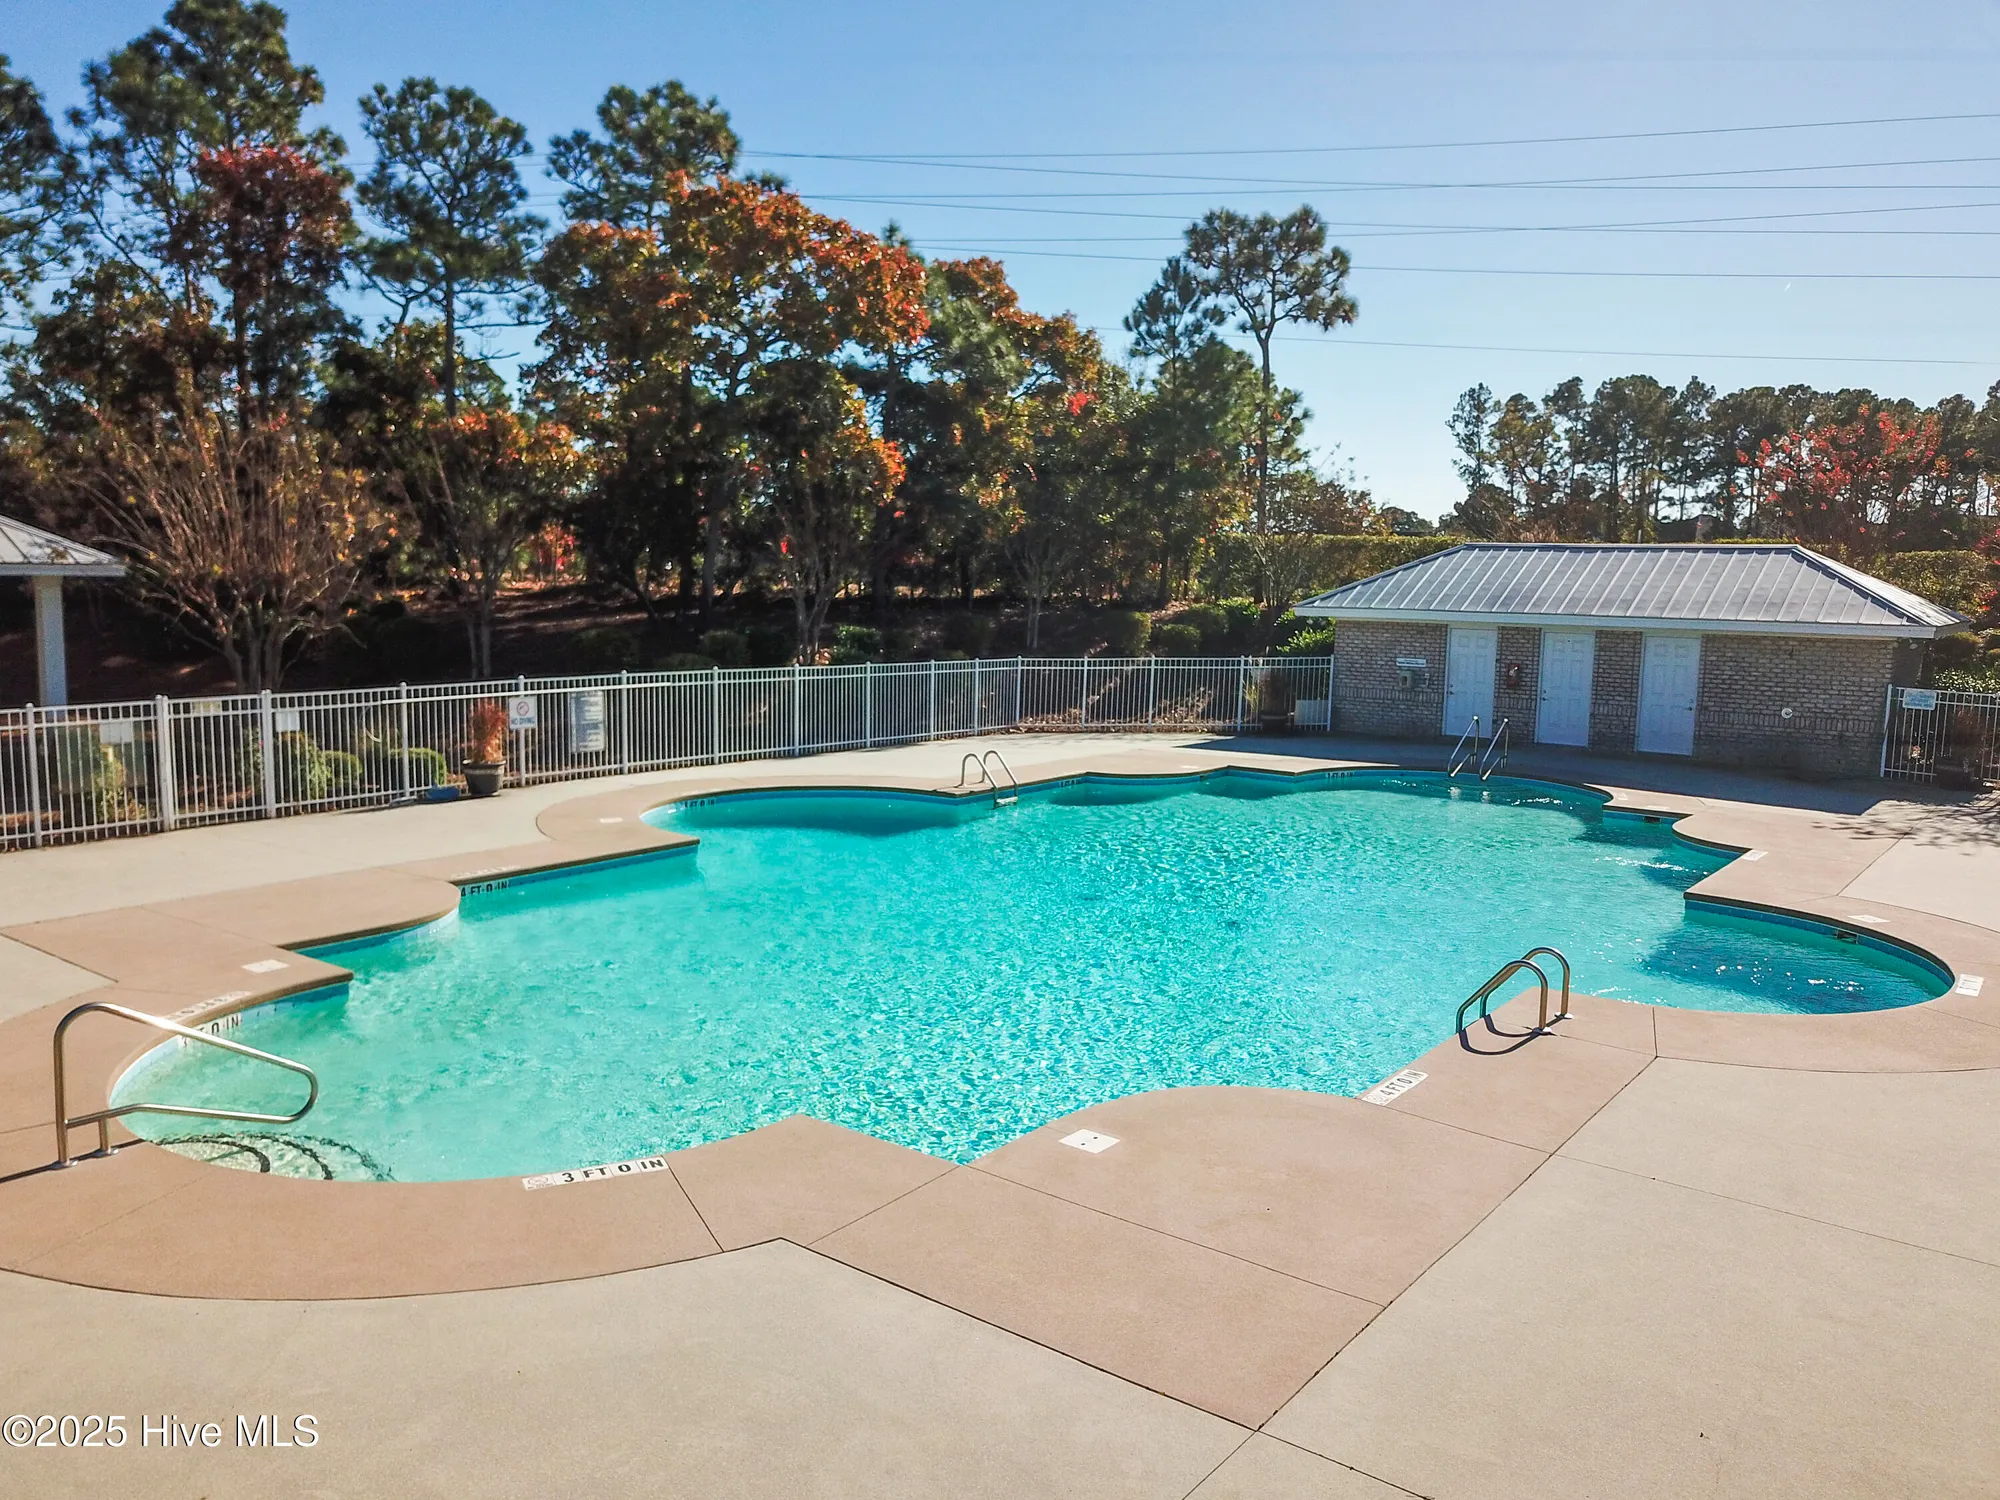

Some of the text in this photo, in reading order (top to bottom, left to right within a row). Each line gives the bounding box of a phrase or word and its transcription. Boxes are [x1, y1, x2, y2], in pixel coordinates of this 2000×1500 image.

[226, 1015, 239, 1030] IN
[562, 1172, 575, 1183] 3
[582, 1166, 607, 1179] FT
[641, 1159, 663, 1169] IN
